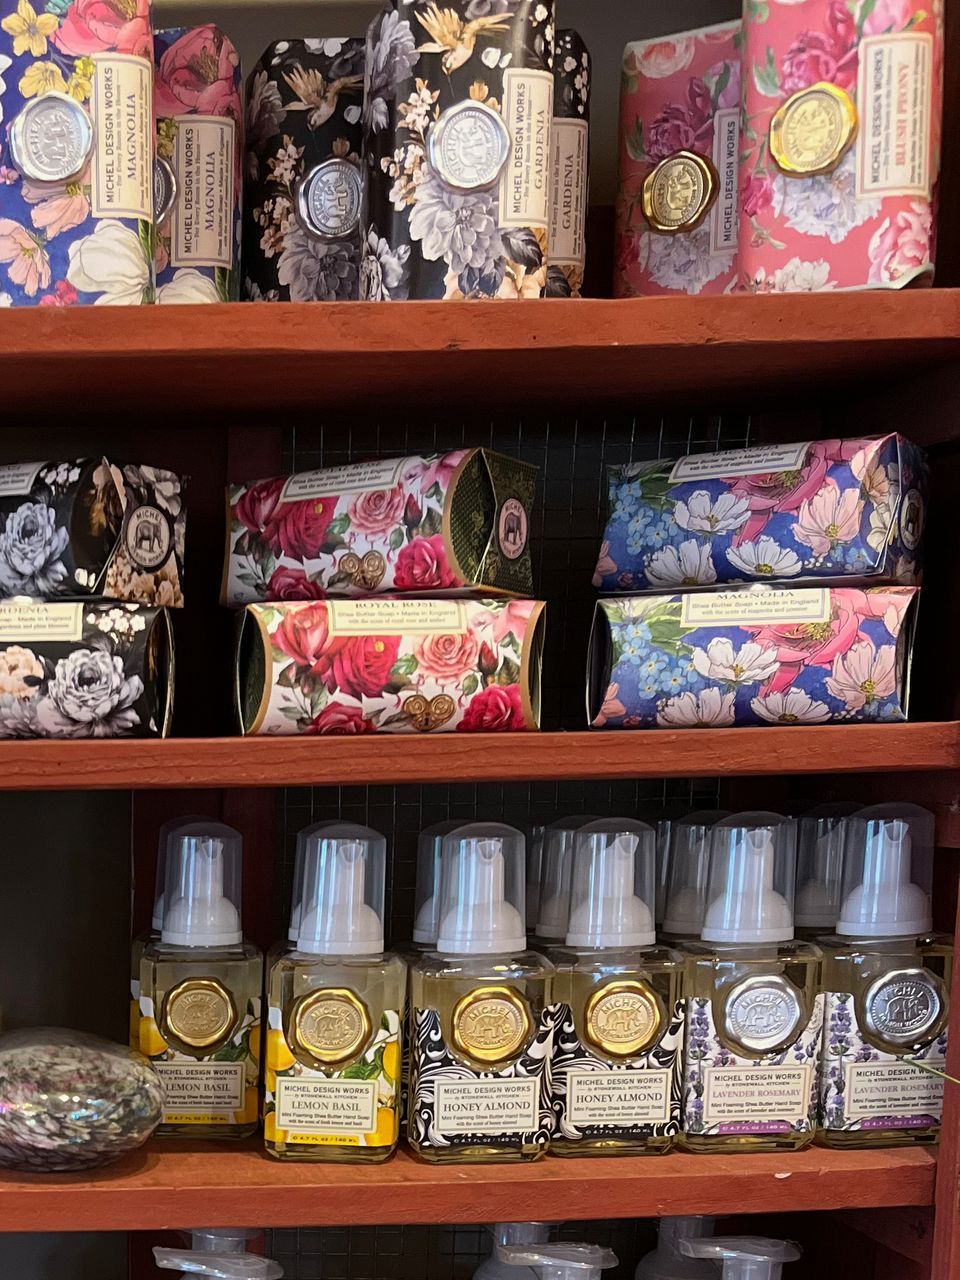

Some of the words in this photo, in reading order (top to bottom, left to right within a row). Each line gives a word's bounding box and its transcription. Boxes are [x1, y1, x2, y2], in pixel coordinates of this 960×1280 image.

[104, 68, 113, 109] WORKS
[516, 83, 525, 123] WORKS
[105, 113, 114, 155] DESIGN
[127, 94, 136, 180] MAGNOLIA
[514, 127, 524, 168] DESIGN
[535, 110, 545, 190] GARDENIA
[726, 121, 735, 159] WORKS
[106, 160, 114, 202] MICHEL
[205, 152, 215, 231] MAGNOLIA
[513, 172, 522, 213] MICHEL
[562, 154, 573, 229] GARDENIA
[725, 162, 733, 199] DESIGN
[724, 204, 732, 241] MICHEL
[314, 1086, 340, 1094] DESIGN
[712, 1090, 755, 1098] LAVENDER
[758, 1089, 801, 1097] ROSEMARY
[714, 1074, 742, 1082] MICHEL
[745, 1073, 773, 1081] DESIGN
[292, 1101, 330, 1111] LEMON
[333, 1102, 361, 1111] BASIL
[444, 1103, 481, 1112] HONEY
[483, 1101, 531, 1111] ALMOND
